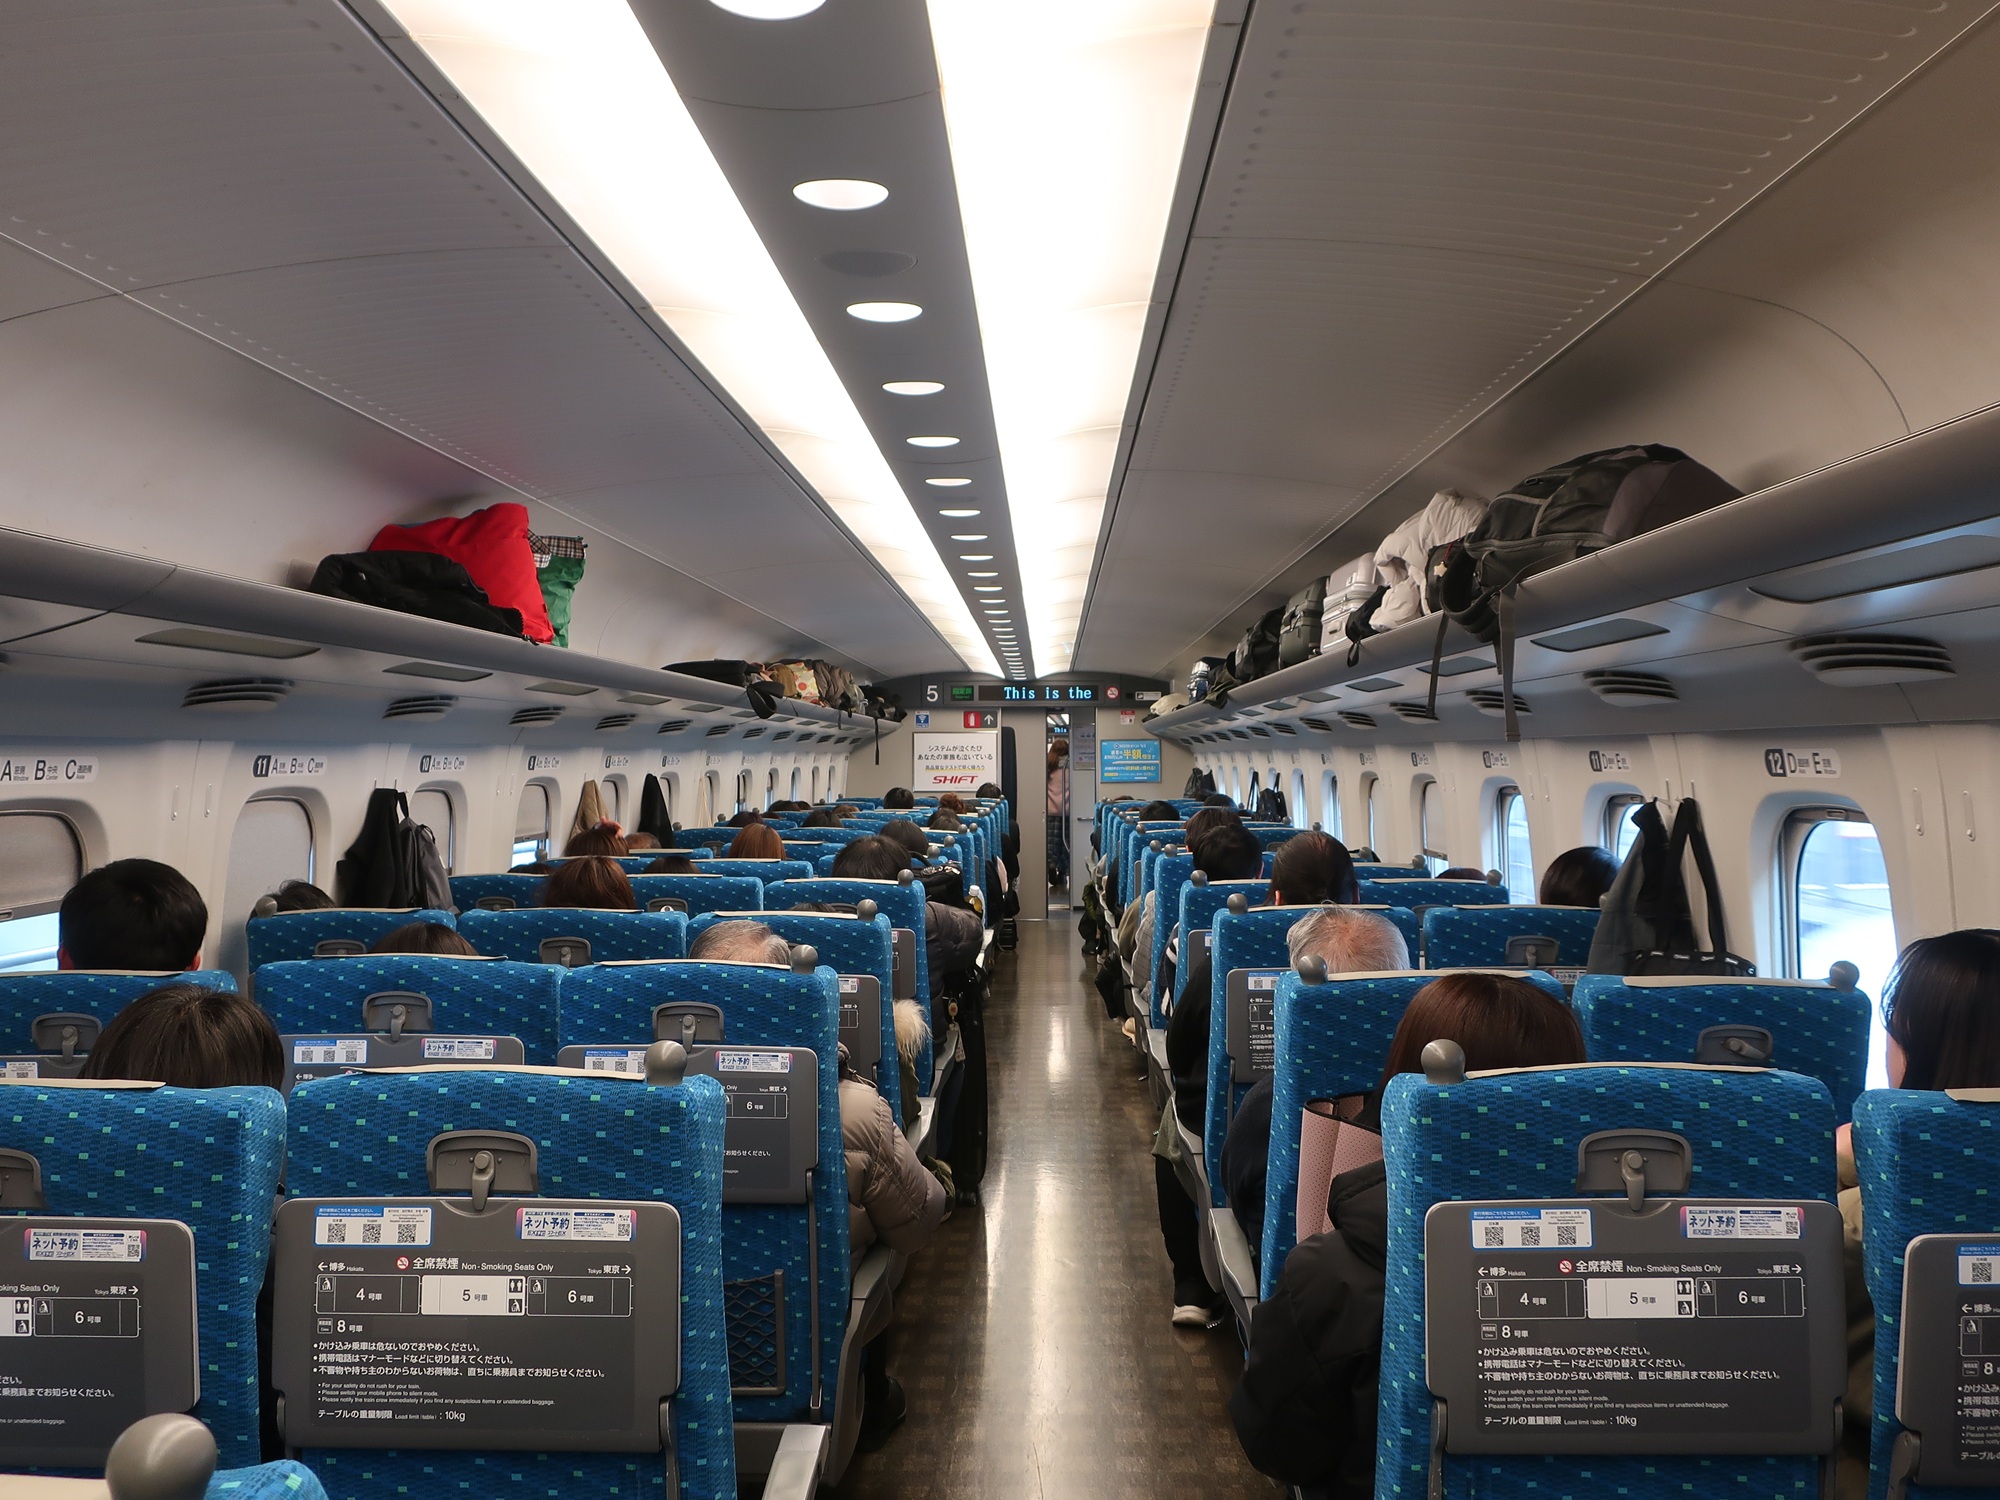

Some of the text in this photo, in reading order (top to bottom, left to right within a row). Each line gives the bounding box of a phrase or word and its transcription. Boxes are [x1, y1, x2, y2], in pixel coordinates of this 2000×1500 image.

[926, 685, 939, 702] 5
[1004, 687, 1092, 699] This is the
[257, 758, 268, 775] 11
[271, 759, 278, 774] A
[290, 758, 298, 773] B
[308, 758, 315, 773] C
[443, 757, 448, 769] B
[1591, 752, 1622, 770] 11 D E
[1768, 753, 1783, 773] 12
[1787, 753, 1797, 773] D
[1812, 753, 1822, 774] E
[0, 760, 12, 781] A
[34, 760, 46, 780] B
[47, 766, 58, 774] 中央
[65, 759, 77, 780] C
[932, 775, 978, 784] SHIFT
[426, 1044, 455, 1052] ネット予約
[721, 1057, 750, 1065] ネット予約
[747, 1102, 753, 1110] 6
[524, 1217, 570, 1230] ネット予約
[1689, 1215, 1736, 1228] ネット予約
[32, 1238, 79, 1250] ネット予約
[329, 1262, 346, 1272] 博多
[413, 1257, 458, 1270] 全席禁煙
[514, 1263, 535, 1271] Seats
[536, 1263, 554, 1273] Only
[603, 1265, 620, 1274] 東京
[1576, 1260, 1624, 1273] 全席禁煙
[1681, 1264, 1703, 1273] Seats
[1704, 1264, 1722, 1274] Only
[1773, 1264, 1790, 1274] 東京
[1490, 1267, 1507, 1276] 博多
[42, 1284, 60, 1293] Only
[110, 1286, 127, 1295] 東京
[356, 1288, 383, 1301] 4 号車
[462, 1289, 471, 1302] 5
[568, 1290, 594, 1303] 6 号車
[1520, 1292, 1547, 1306] 4 号車
[1629, 1292, 1639, 1304] 5
[1738, 1291, 1748, 1304] 6
[1974, 1303, 1992, 1313] 博多
[75, 1311, 84, 1323] 6
[337, 1320, 346, 1333] 8
[349, 1325, 363, 1333] 号車
[1502, 1325, 1511, 1338] 8
[1514, 1330, 1529, 1338] 号車
[318, 1342, 480, 1352] かけ込み乗車は危ないのでおやめください。
[1483, 1346, 1651, 1356] かけ込み乗車は危ないのでおやめください。
[319, 1353, 513, 1365] 携帯電話はマナーモードなどに切り替えてください。
[1483, 1359, 1686, 1369] 携帯電話はマナーモードなどに切り替えてください。
[319, 1366, 605, 1378] 不審物や持ち主のわからないお荷物は、直ちに乗務員までお知らせください。
[1984, 1362, 1993, 1375] 8
[1484, 1371, 1781, 1381] 不審物や持ち主のわからないお荷物は、直ちに乗務員までお知らせください。
[318, 1410, 393, 1419] テーブルの重量制限
[445, 1411, 466, 1422] 10kg
[1484, 1416, 1561, 1425] テーブルの重量制限
[1616, 1416, 1637, 1427] 10kg
